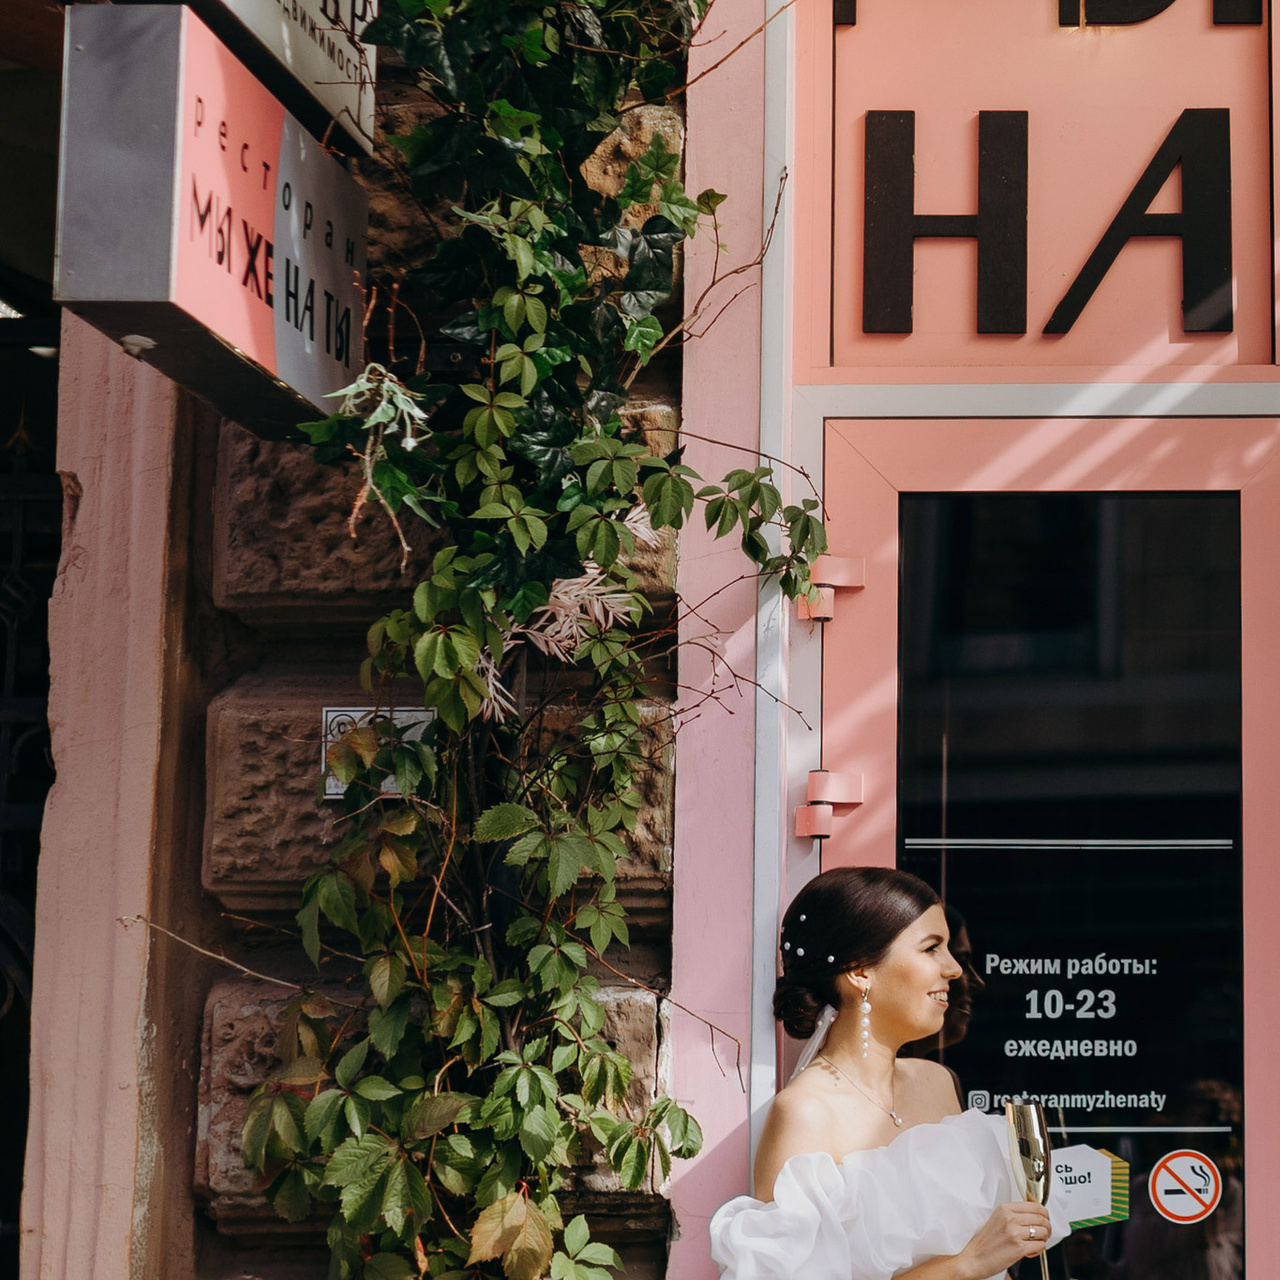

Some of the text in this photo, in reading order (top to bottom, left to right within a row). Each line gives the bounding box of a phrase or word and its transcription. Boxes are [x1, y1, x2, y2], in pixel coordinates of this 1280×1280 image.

[193, 95, 355, 268] ресторан
[862, 107, 1234, 336] НА
[242, 217, 274, 310] ЖЕ
[284, 256, 316, 343] НА
[324, 288, 352, 369] ТЫ
[985, 952, 1158, 979] Режим работы:
[1025, 989, 1117, 1019] 10-23
[1004, 1037, 1138, 1060] ежедневно
